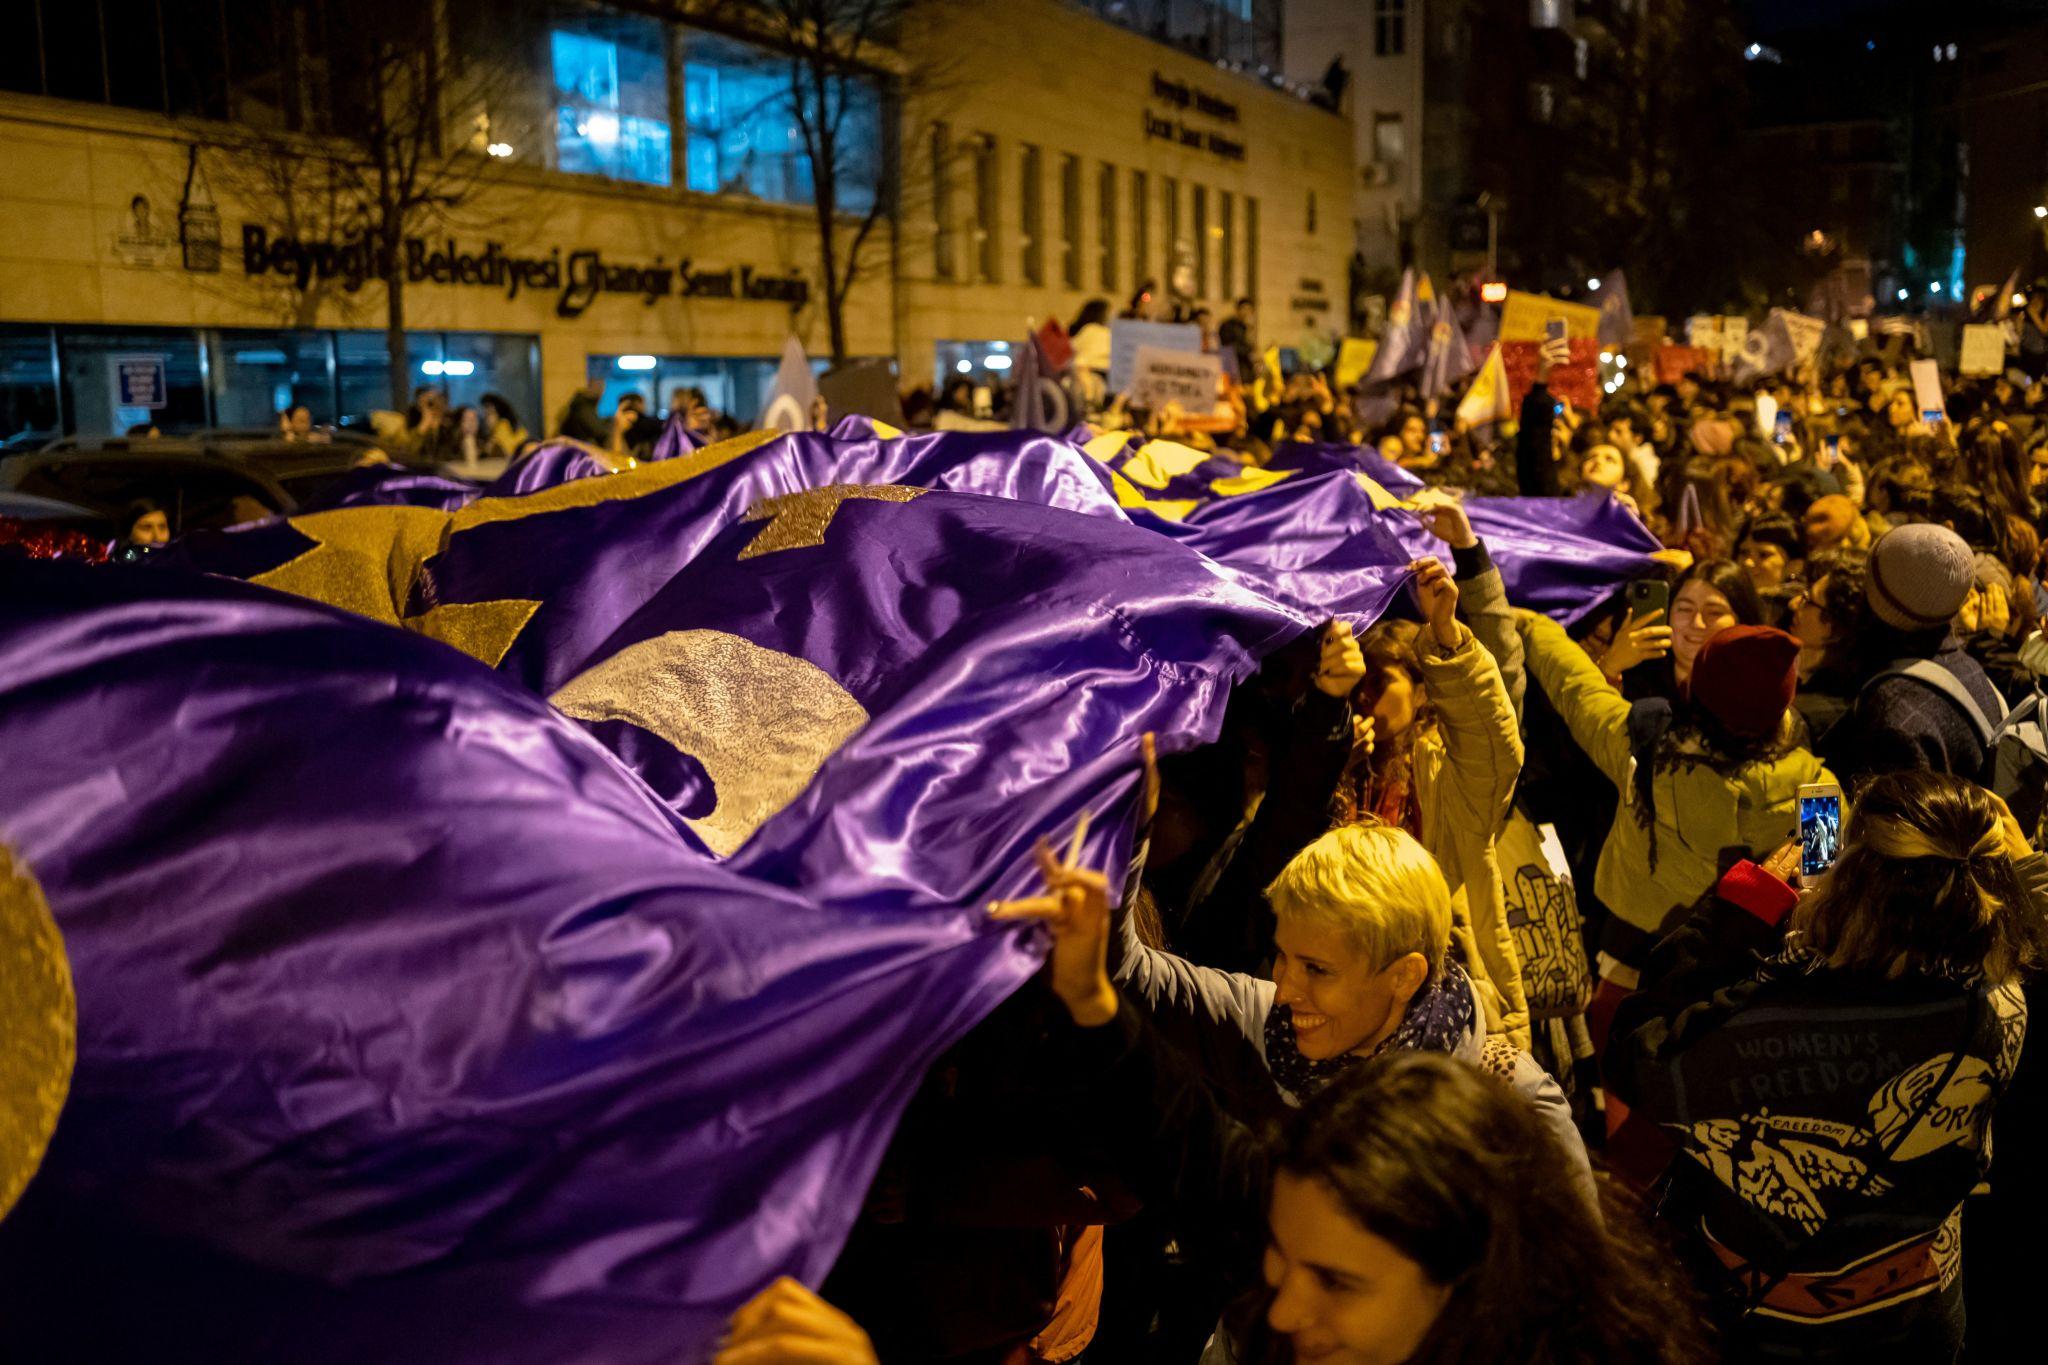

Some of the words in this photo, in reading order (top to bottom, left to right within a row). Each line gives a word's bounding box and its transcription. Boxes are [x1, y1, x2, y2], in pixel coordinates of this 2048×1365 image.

[405, 238, 561, 299] Belediyesi
[1734, 1031, 1879, 1059] WOMEN'S
[1729, 1052, 1902, 1104] FREEDOM
